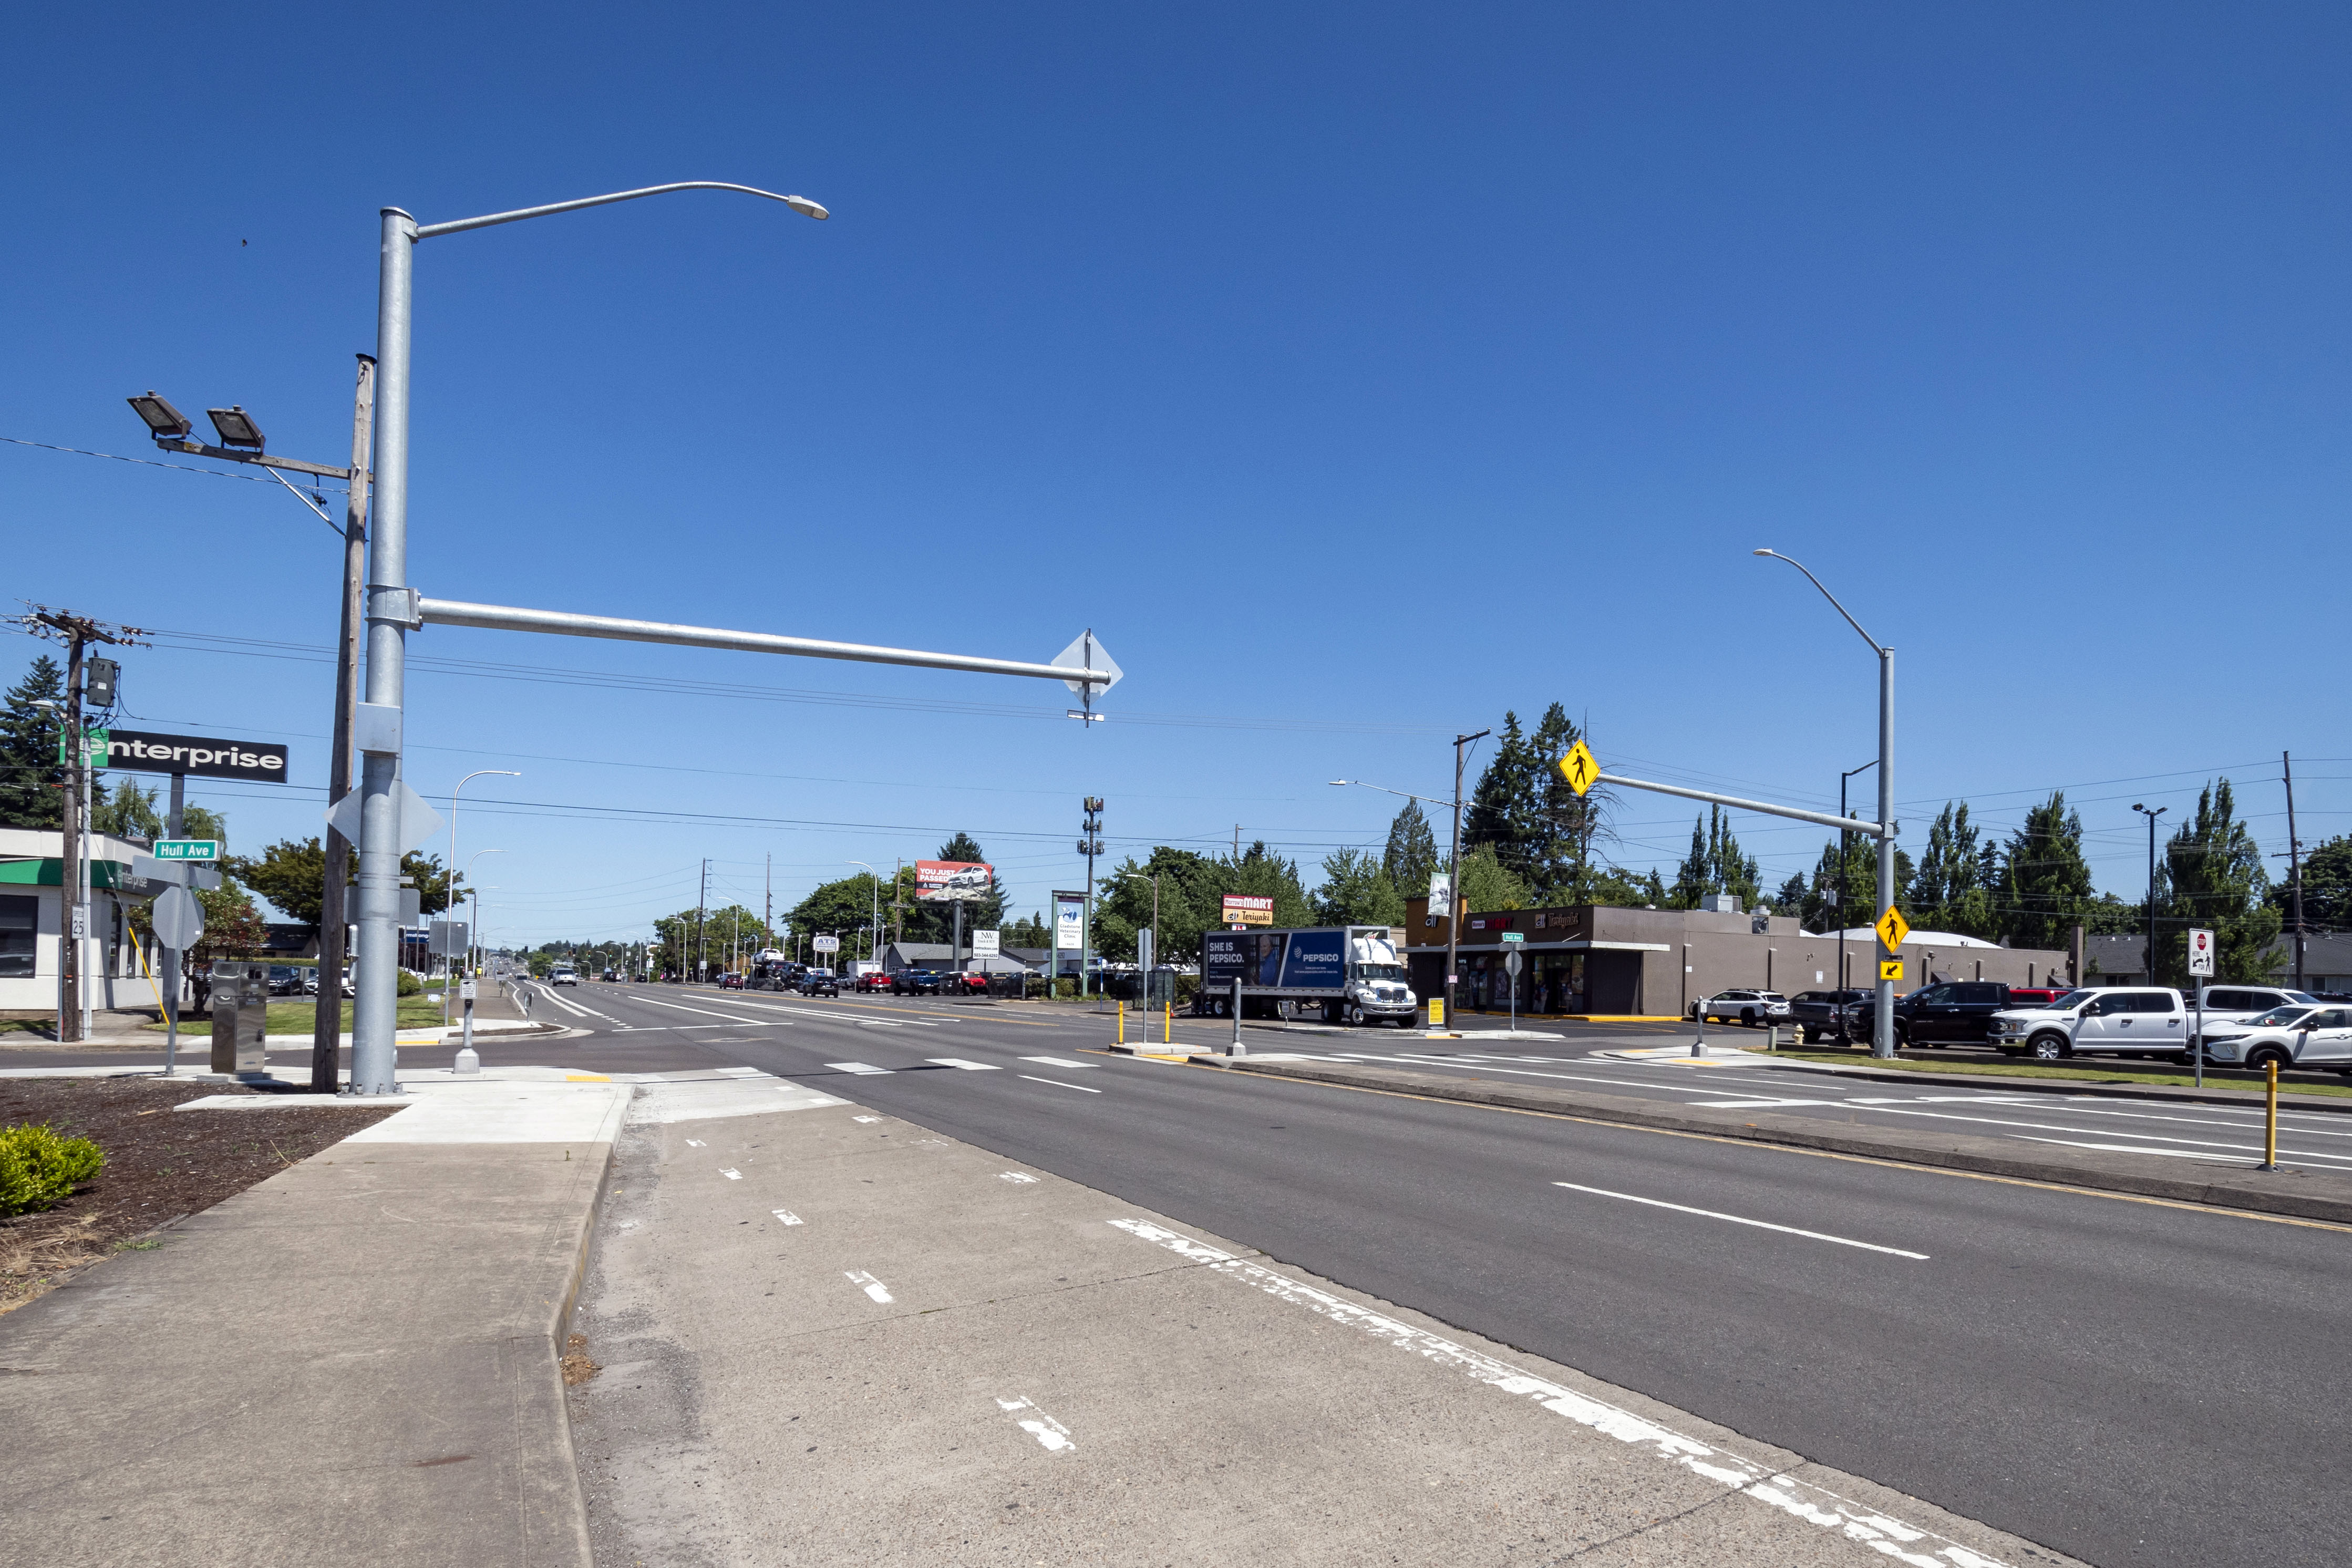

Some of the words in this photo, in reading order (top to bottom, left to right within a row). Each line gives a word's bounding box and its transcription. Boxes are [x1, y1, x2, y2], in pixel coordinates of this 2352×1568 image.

[80, 737, 283, 769] enterprise
[161, 844, 183, 856] Hull
[188, 844, 209, 856] Ave
[117, 869, 148, 889] enterprise
[1243, 897, 1273, 910] MART
[1242, 911, 1270, 923] Teriyaki
[1548, 912, 1579, 929] Teriyaki
[73, 920, 84, 935] 25
[1209, 942, 1224, 952] SHE
[1226, 942, 1233, 951] IS
[1209, 953, 1244, 963] PEPSICO.
[1303, 954, 1339, 962] PEPSICO
